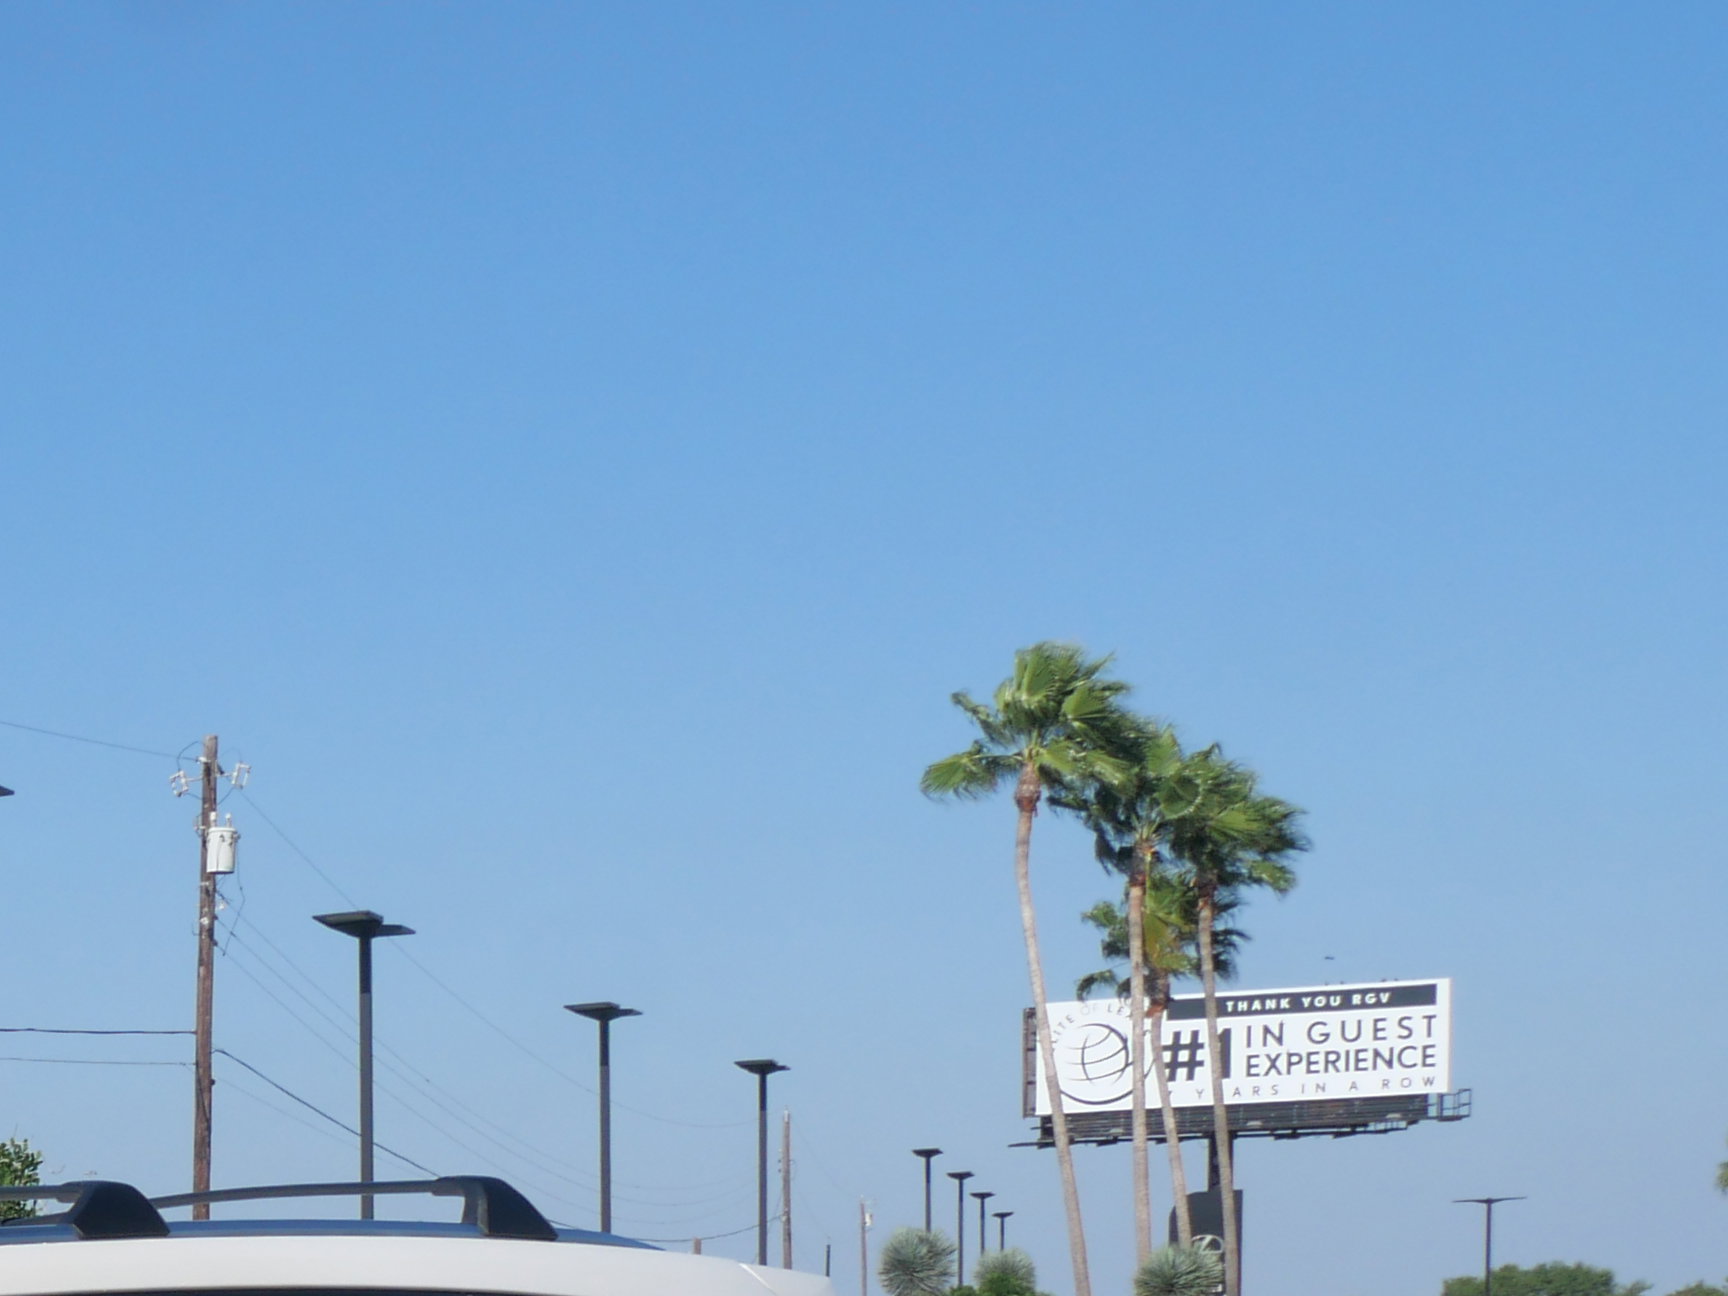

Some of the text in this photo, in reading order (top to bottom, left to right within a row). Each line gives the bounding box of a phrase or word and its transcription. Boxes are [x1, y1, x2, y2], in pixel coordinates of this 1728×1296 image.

[1226, 991, 1392, 1013] THANK YOU RGV
[1246, 1014, 1437, 1049] IN GUEST
[1162, 1027, 1232, 1083] #1
[1246, 1044, 1437, 1078] EXPERIENCE
[1195, 1075, 1436, 1099] YARS IN A ROW
